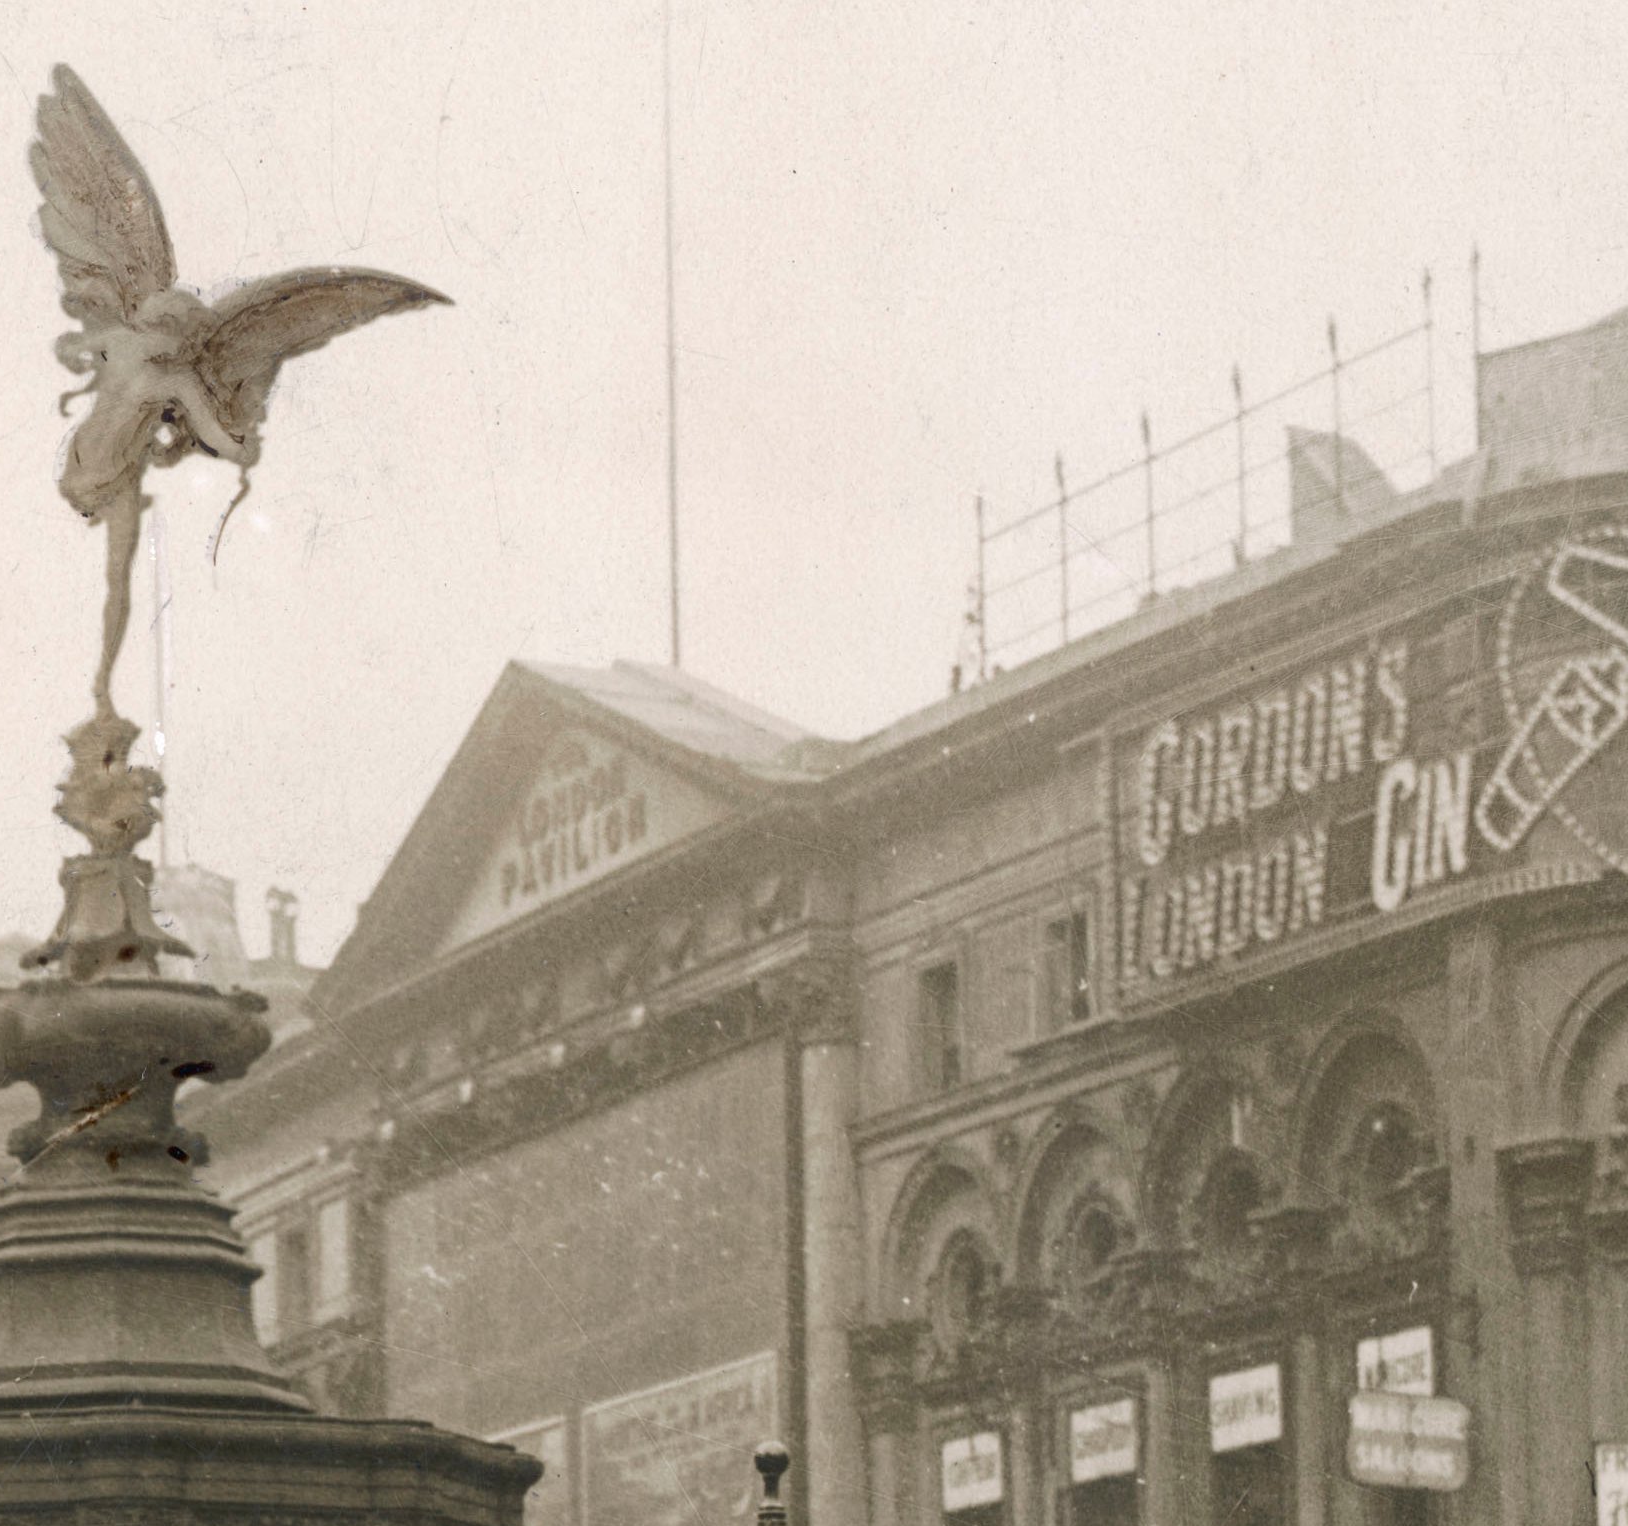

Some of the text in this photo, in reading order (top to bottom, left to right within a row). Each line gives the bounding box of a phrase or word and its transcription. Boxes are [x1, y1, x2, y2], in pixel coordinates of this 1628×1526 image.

[500, 790, 649, 910] PAVILION
[1122, 828, 1328, 984] LONDON
[1375, 754, 1472, 912] GIN
